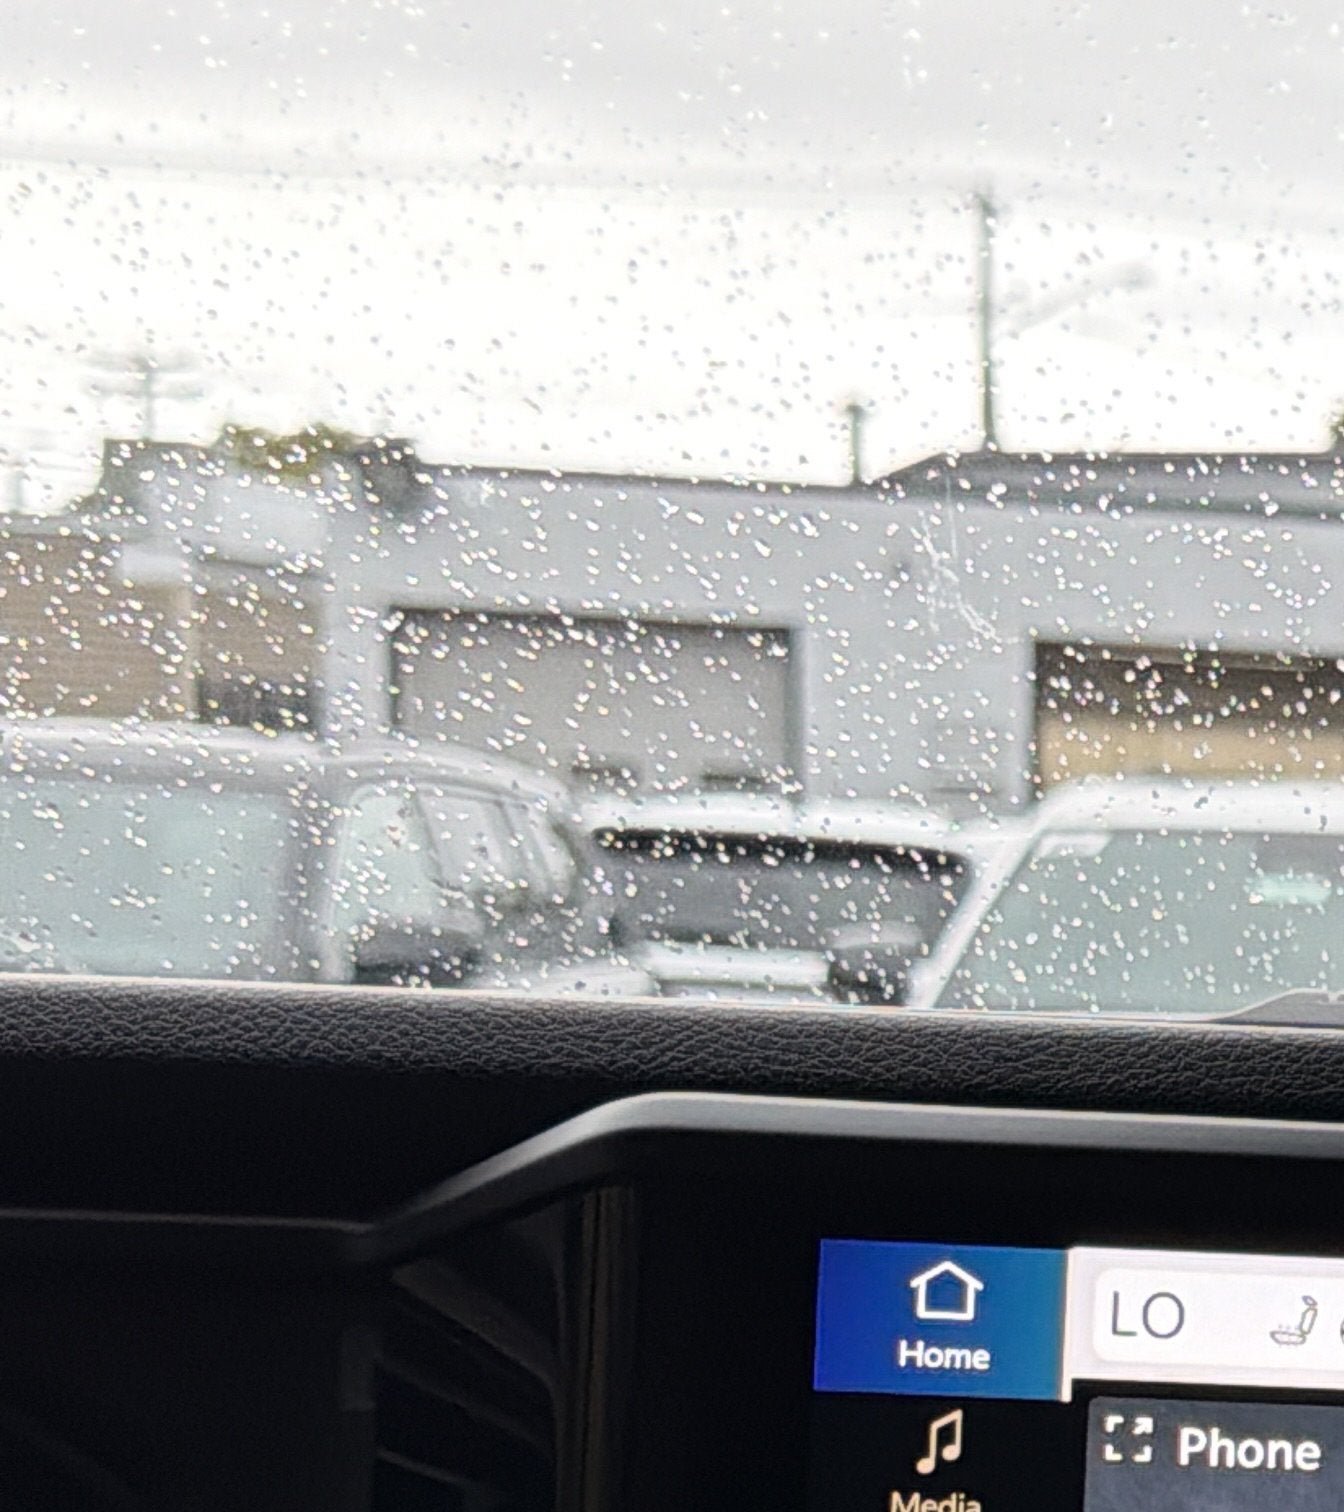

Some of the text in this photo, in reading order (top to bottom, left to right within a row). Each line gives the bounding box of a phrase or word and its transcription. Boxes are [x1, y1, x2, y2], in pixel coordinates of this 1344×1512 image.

[1111, 1290, 1186, 1339] LO
[898, 1340, 991, 1371] Home
[1177, 1426, 1323, 1473] Phone
